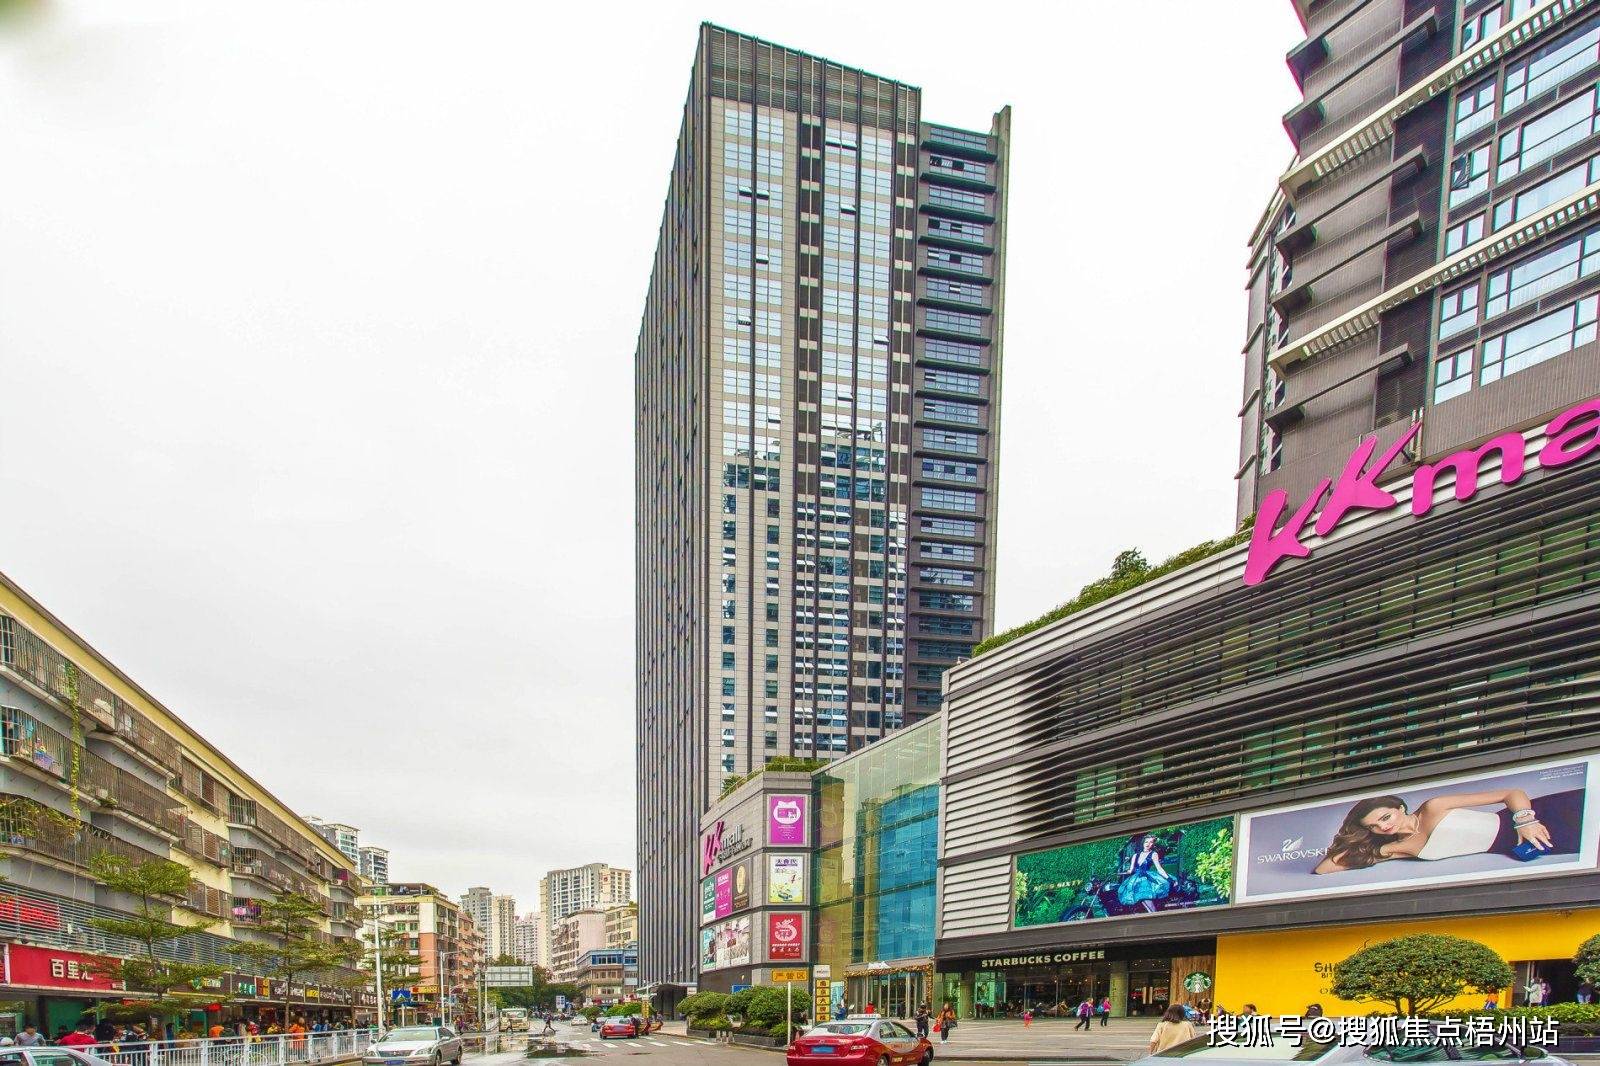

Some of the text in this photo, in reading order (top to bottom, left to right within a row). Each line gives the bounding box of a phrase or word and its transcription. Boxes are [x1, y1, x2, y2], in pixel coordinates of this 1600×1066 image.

[1257, 847, 1329, 864] SWAROVSKI
[981, 950, 1105, 968] STARBUCKS COFFEE
